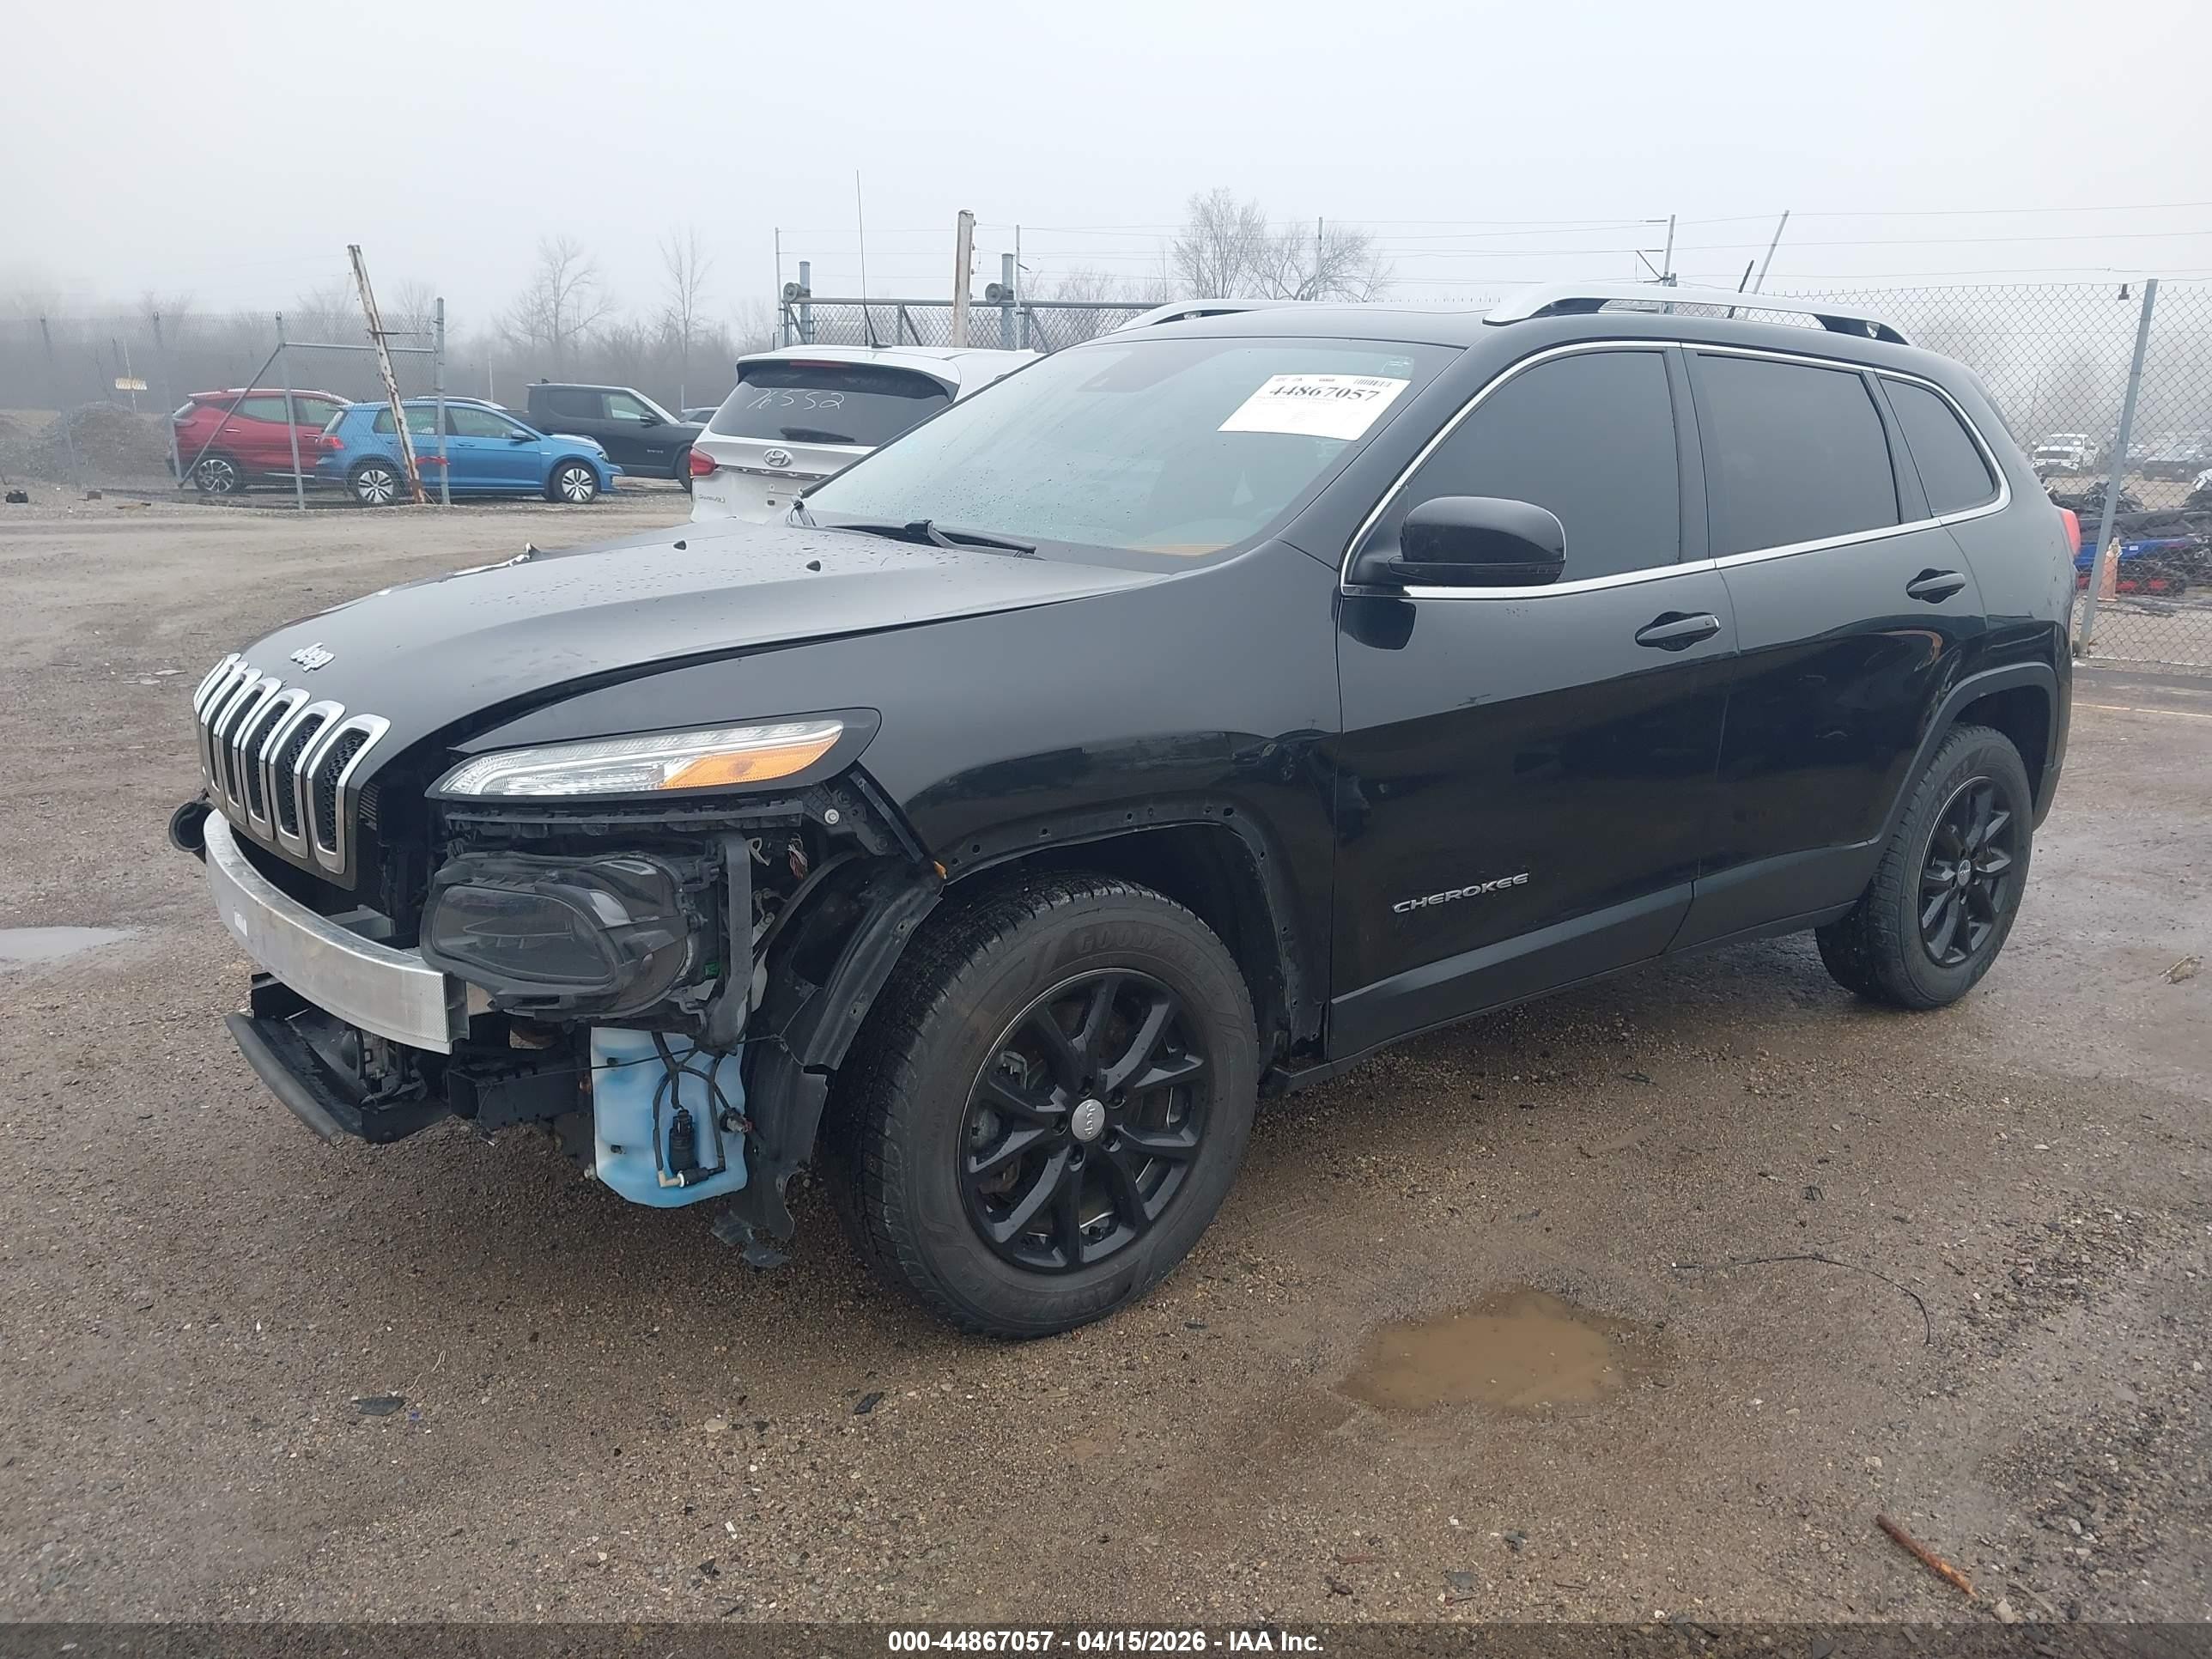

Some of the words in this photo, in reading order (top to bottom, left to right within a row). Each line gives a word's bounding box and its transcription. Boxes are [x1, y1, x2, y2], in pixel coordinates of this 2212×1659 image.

[1269, 385, 1381, 402] 44867057
[1392, 872, 1531, 914] CHEROKEE
[1084, 1103, 1097, 1136] Jeep
